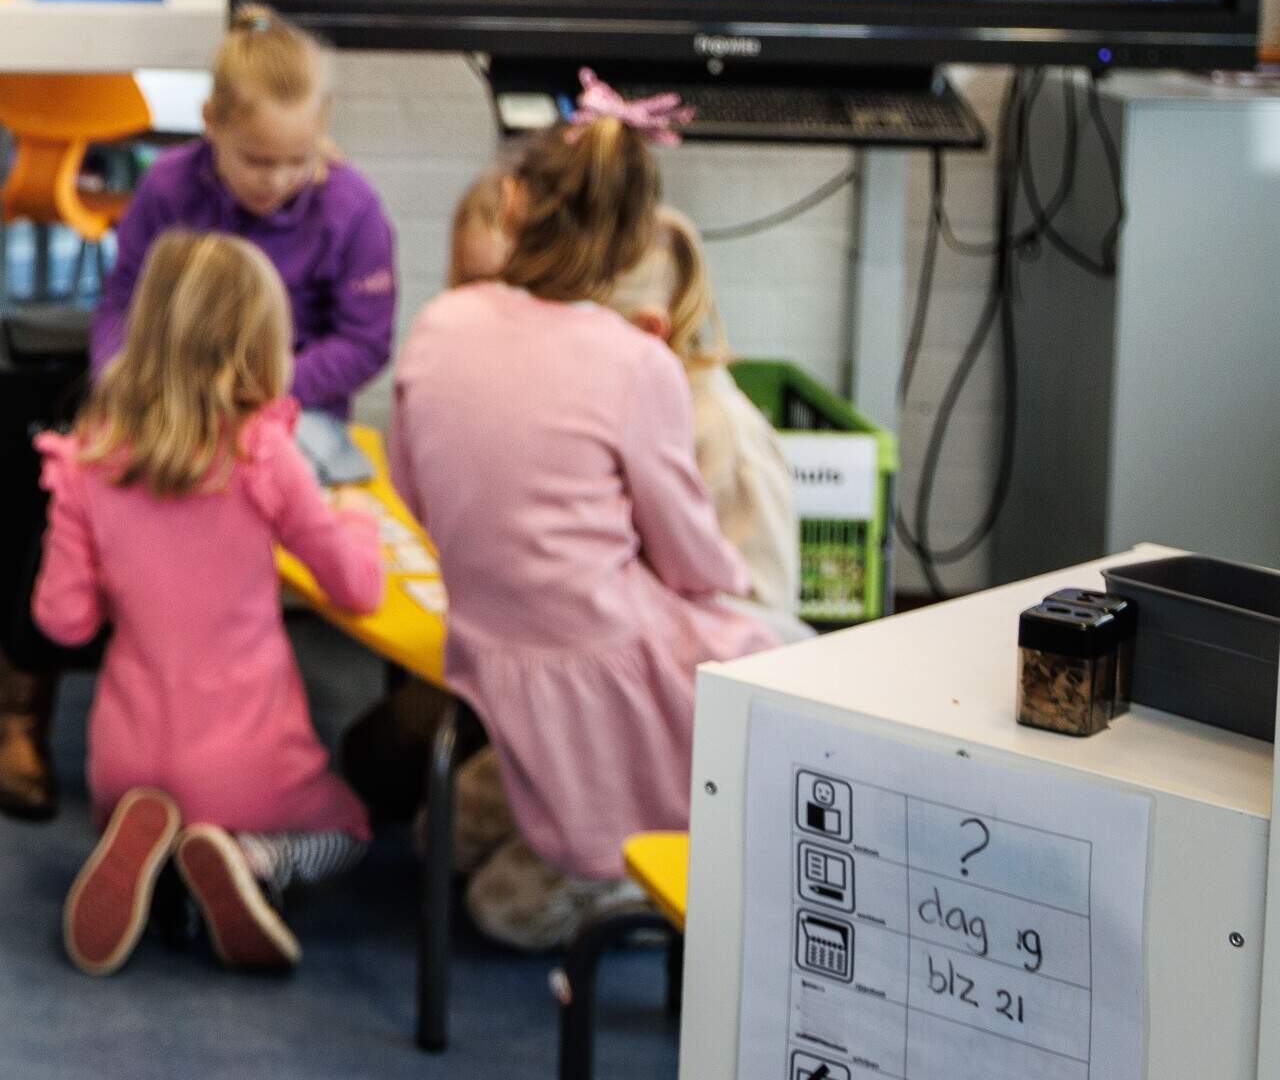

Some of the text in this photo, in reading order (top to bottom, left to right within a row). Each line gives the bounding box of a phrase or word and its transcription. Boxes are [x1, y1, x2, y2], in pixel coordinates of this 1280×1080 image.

[918, 886, 988, 957] dag
[928, 954, 1024, 1023] blz 21
